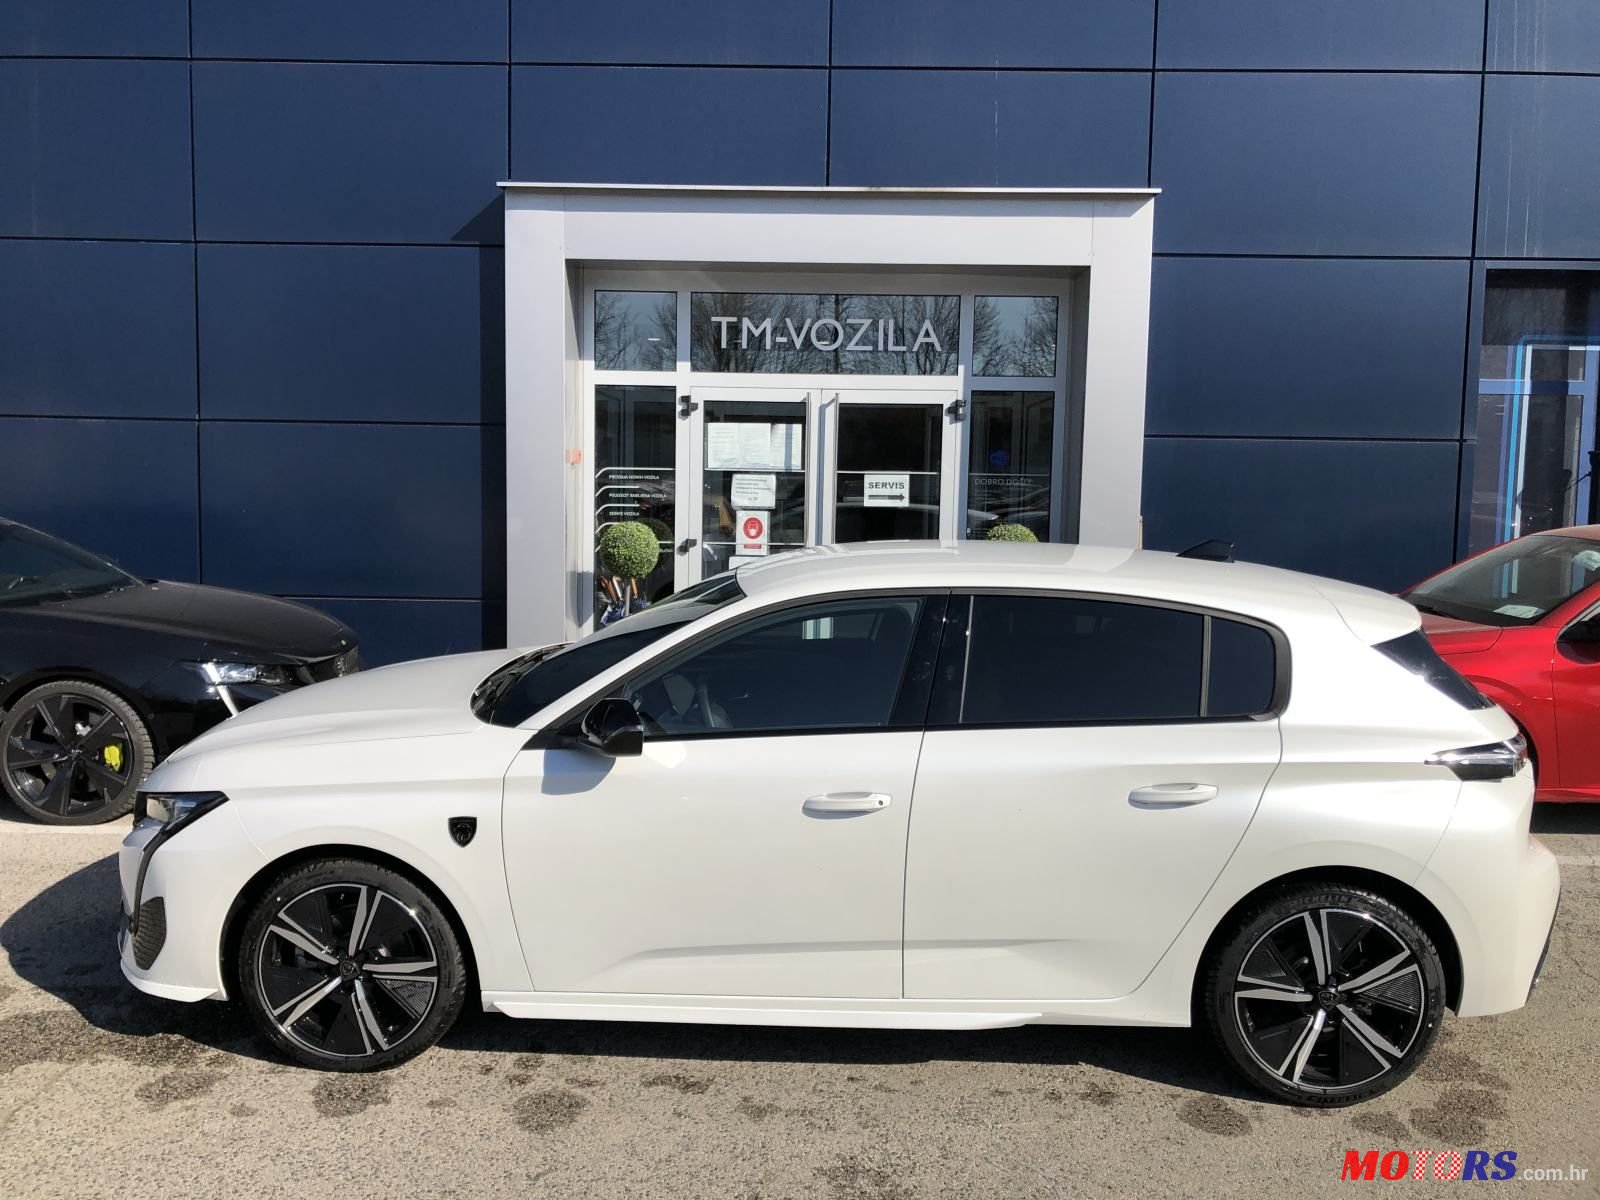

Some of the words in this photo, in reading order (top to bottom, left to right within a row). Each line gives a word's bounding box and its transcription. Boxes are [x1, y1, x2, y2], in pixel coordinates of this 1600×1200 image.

[711, 316, 942, 351] TM-VOZILA
[868, 481, 905, 489] SERVIS
[974, 478, 1004, 486] DOBRO
